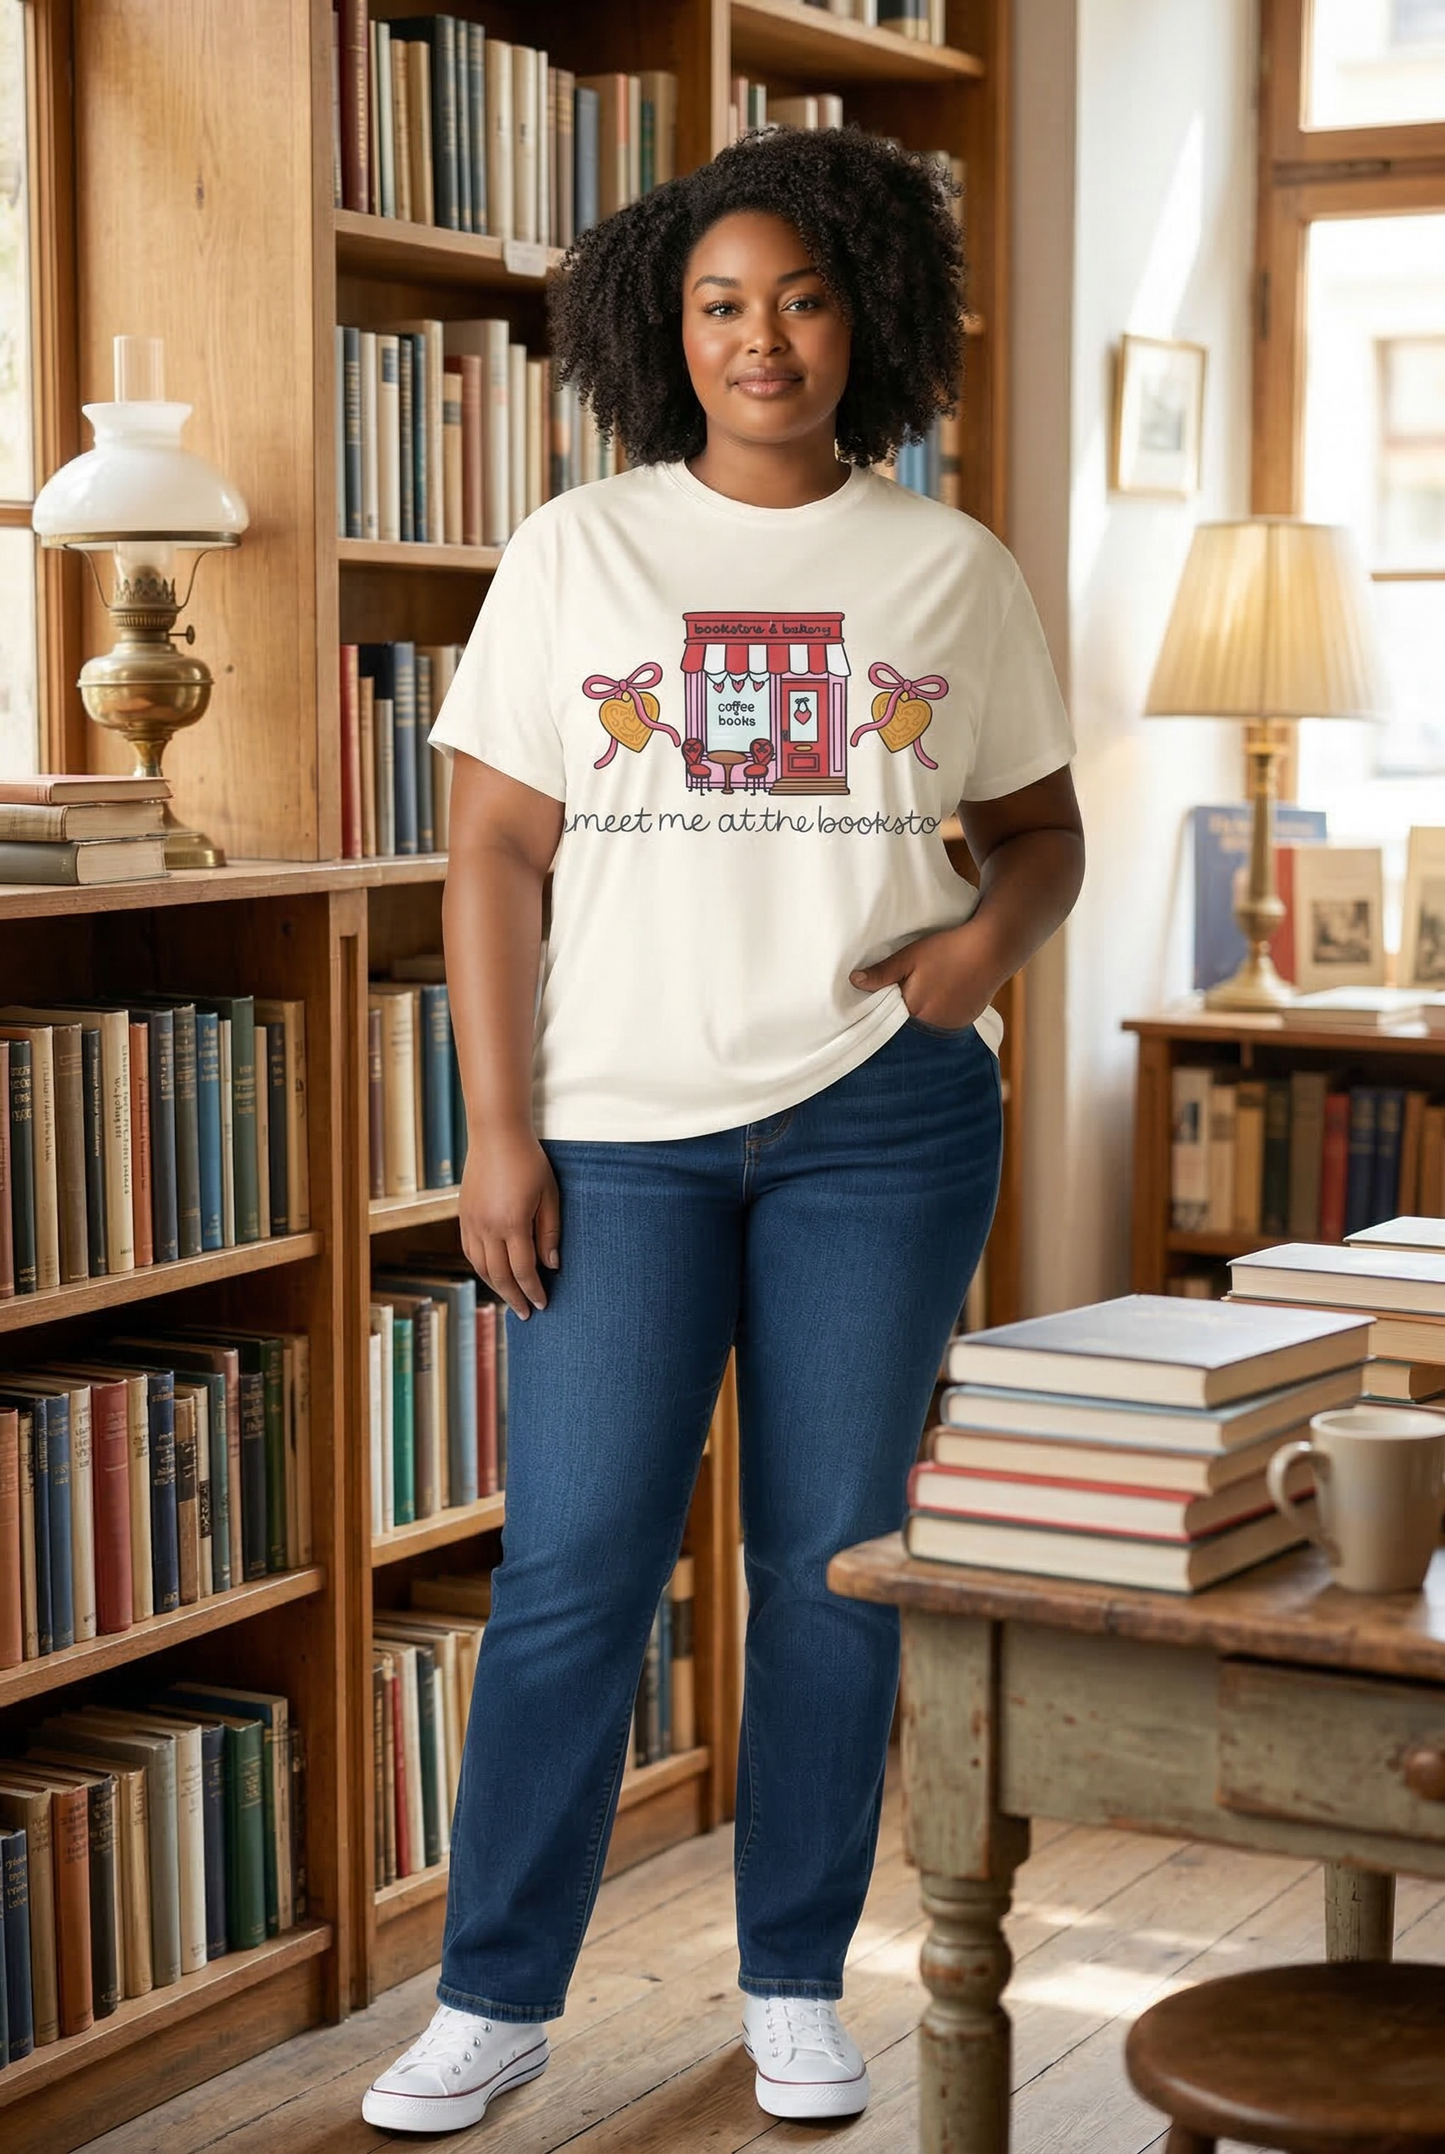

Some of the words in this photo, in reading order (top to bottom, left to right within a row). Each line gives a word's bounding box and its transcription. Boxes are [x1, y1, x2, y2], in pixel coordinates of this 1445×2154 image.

[718, 700, 755, 712] coffee
[718, 714, 756, 727] books
[565, 806, 653, 833] meet
[658, 813, 711, 832] me
[718, 807, 756, 833] at
[755, 806, 815, 833] the
